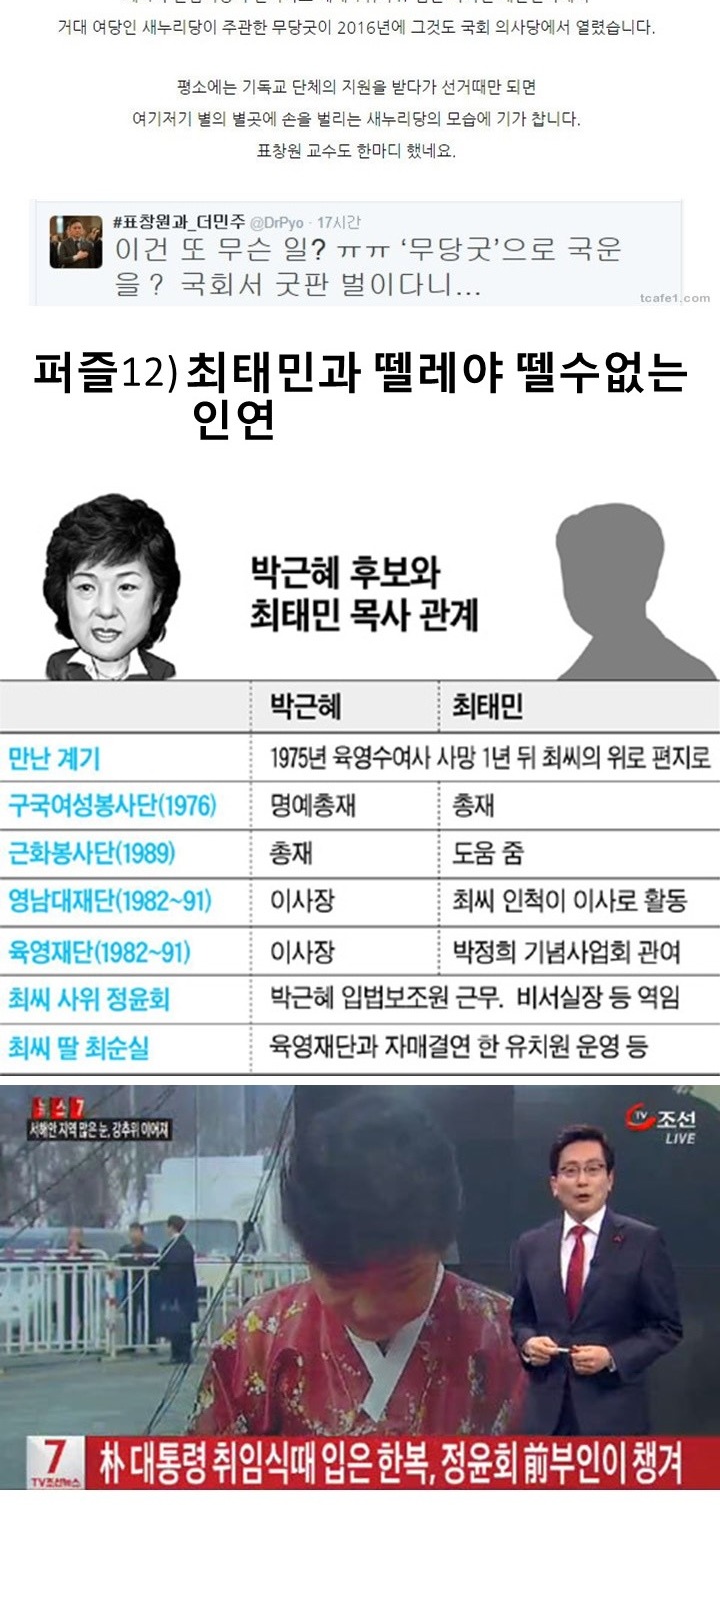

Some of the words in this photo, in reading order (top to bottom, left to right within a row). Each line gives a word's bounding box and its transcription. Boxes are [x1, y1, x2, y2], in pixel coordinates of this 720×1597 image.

[113, 213, 246, 232] #표창원과_더민주
[249, 215, 305, 232] @DrPyo
[317, 214, 362, 230] 17시간
[251, 555, 339, 590] 박근혜
[350, 555, 441, 590] 후보와
[250, 597, 340, 633] 최태민
[350, 597, 412, 633] 목사
[419, 597, 478, 633] 관계
[271, 692, 341, 721] 박근혜
[452, 692, 523, 721] 최태민
[7, 792, 218, 819] 구국여성봉사단(1976)
[271, 792, 356, 818] 명예총재
[452, 792, 494, 818] 총재
